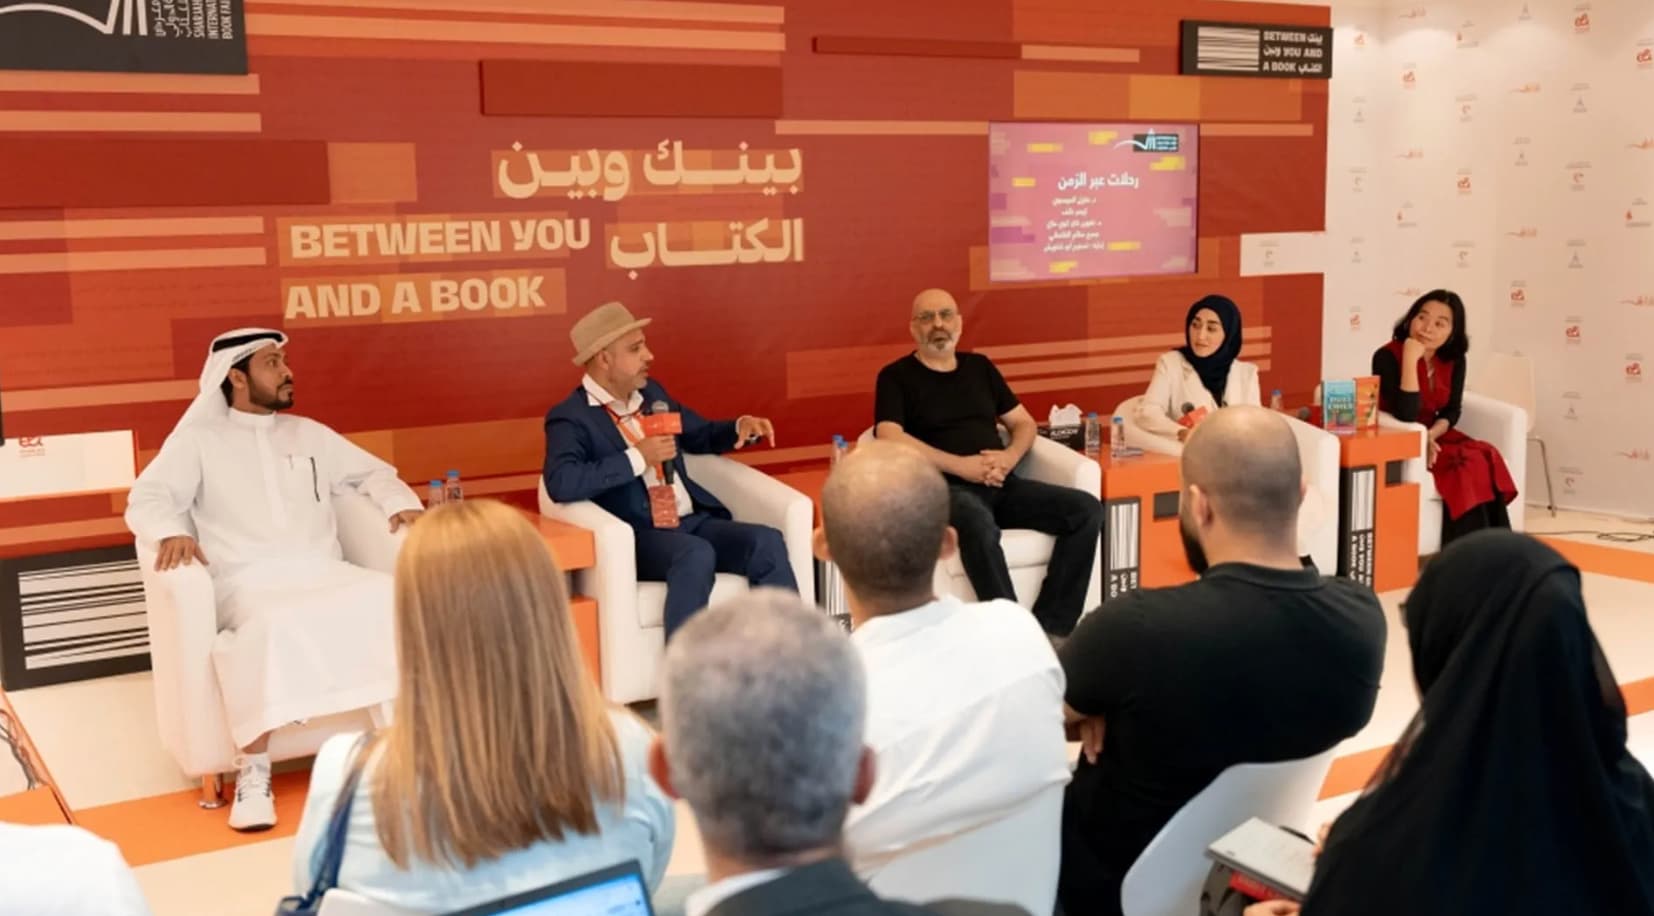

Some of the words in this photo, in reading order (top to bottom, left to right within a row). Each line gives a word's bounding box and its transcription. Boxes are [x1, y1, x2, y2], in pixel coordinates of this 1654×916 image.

[205, 0, 219, 39] INTERNAT
[221, 15, 233, 39] BOOK
[1263, 31, 1306, 42] BETWEEN
[1303, 48, 1323, 58] AND
[1263, 61, 1269, 71] A
[1271, 61, 1296, 72] BOOK
[498, 140, 631, 201] وبين
[643, 139, 802, 195] بينك
[1057, 171, 1087, 190] الزمن
[1089, 175, 1105, 190] عبر
[1107, 171, 1139, 189] رحلات
[290, 220, 501, 259] BETWEEN
[609, 217, 804, 281] الكتاب
[283, 283, 381, 320] AND
[391, 281, 422, 314] A
[430, 275, 545, 313] BOOK
